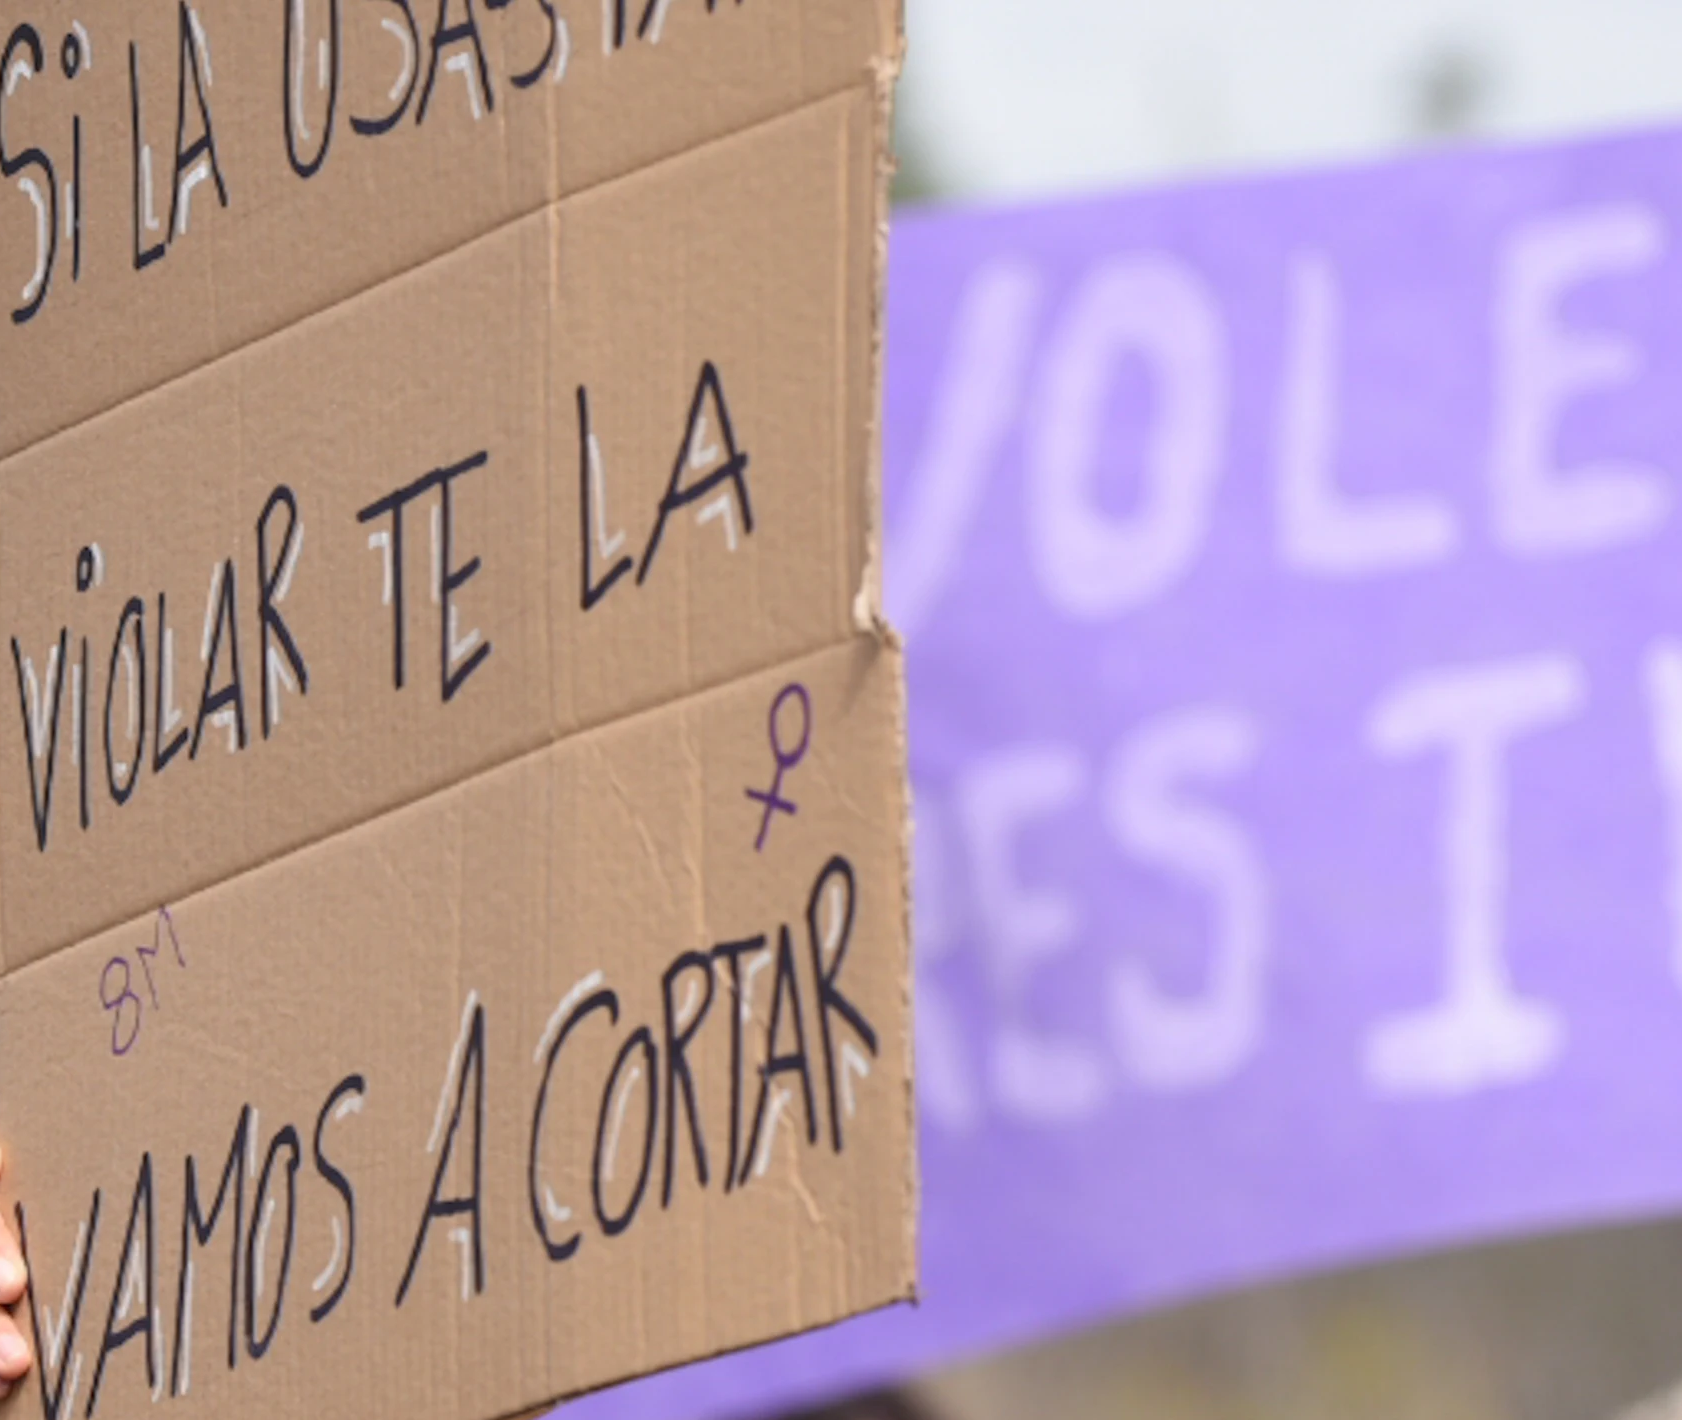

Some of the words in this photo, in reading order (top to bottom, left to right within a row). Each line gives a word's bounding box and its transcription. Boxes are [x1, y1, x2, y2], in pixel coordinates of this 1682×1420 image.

[128, 0, 228, 270] LA
[356, 450, 491, 703] TE
[576, 360, 754, 612] LA
[98, 903, 186, 1056] 8M
[395, 992, 485, 1307] A
[528, 854, 879, 1262] CORTAR
